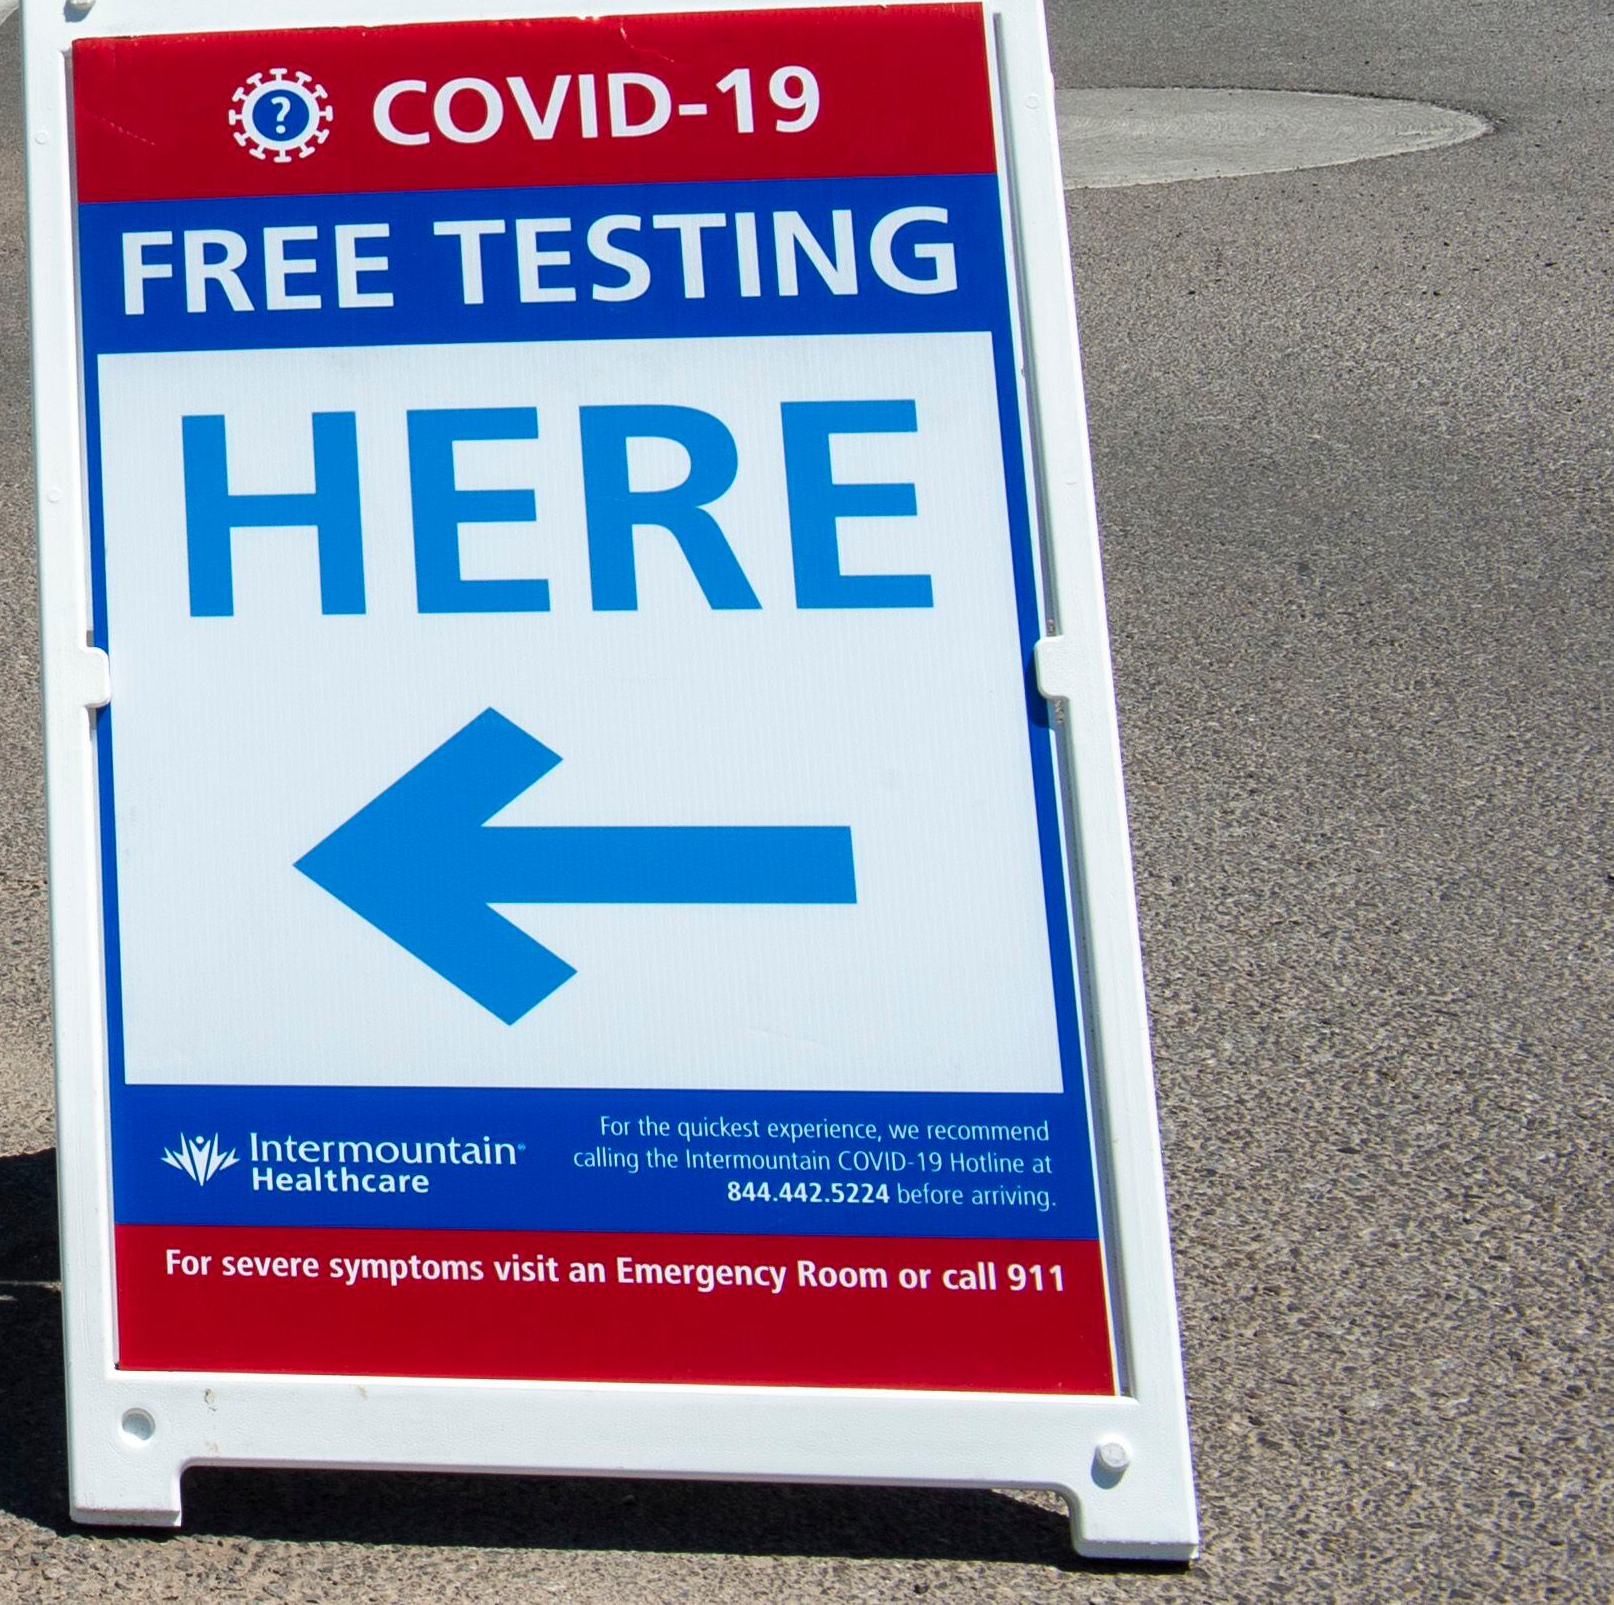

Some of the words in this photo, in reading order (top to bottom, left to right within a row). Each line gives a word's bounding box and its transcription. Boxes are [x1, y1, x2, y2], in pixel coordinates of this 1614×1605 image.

[372, 65, 820, 145] COVID-19
[120, 223, 394, 316] FREE
[434, 207, 957, 305] TESTING
[182, 399, 934, 617] HERE
[600, 1116, 630, 1137] For
[638, 1116, 670, 1138] the
[677, 1116, 760, 1143] quickest
[767, 1118, 882, 1143] experience,
[889, 1123, 919, 1140] we
[927, 1121, 1049, 1142] recommend
[250, 1132, 516, 1164] Intermountain
[573, 1149, 639, 1173] calling
[646, 1150, 678, 1169] the
[686, 1149, 831, 1171] Intermountain
[838, 1151, 943, 1173] COVID-19
[950, 1152, 1024, 1174] Hotline
[1032, 1155, 1053, 1174] at
[252, 1167, 429, 1193] Healthcare
[727, 1180, 890, 1205] 844.442.5224
[897, 1183, 964, 1206] before
[972, 1184, 1057, 1212] arriving.
[166, 1249, 212, 1275] For
[222, 1256, 319, 1278] severe
[329, 1255, 484, 1286] symptoms
[493, 1254, 559, 1282] visit
[569, 1261, 605, 1283] an
[616, 1257, 787, 1293] Emergency
[798, 1260, 888, 1288] Room
[898, 1267, 930, 1289] or
[943, 1262, 996, 1291] call
[1007, 1264, 1064, 1292] 911
